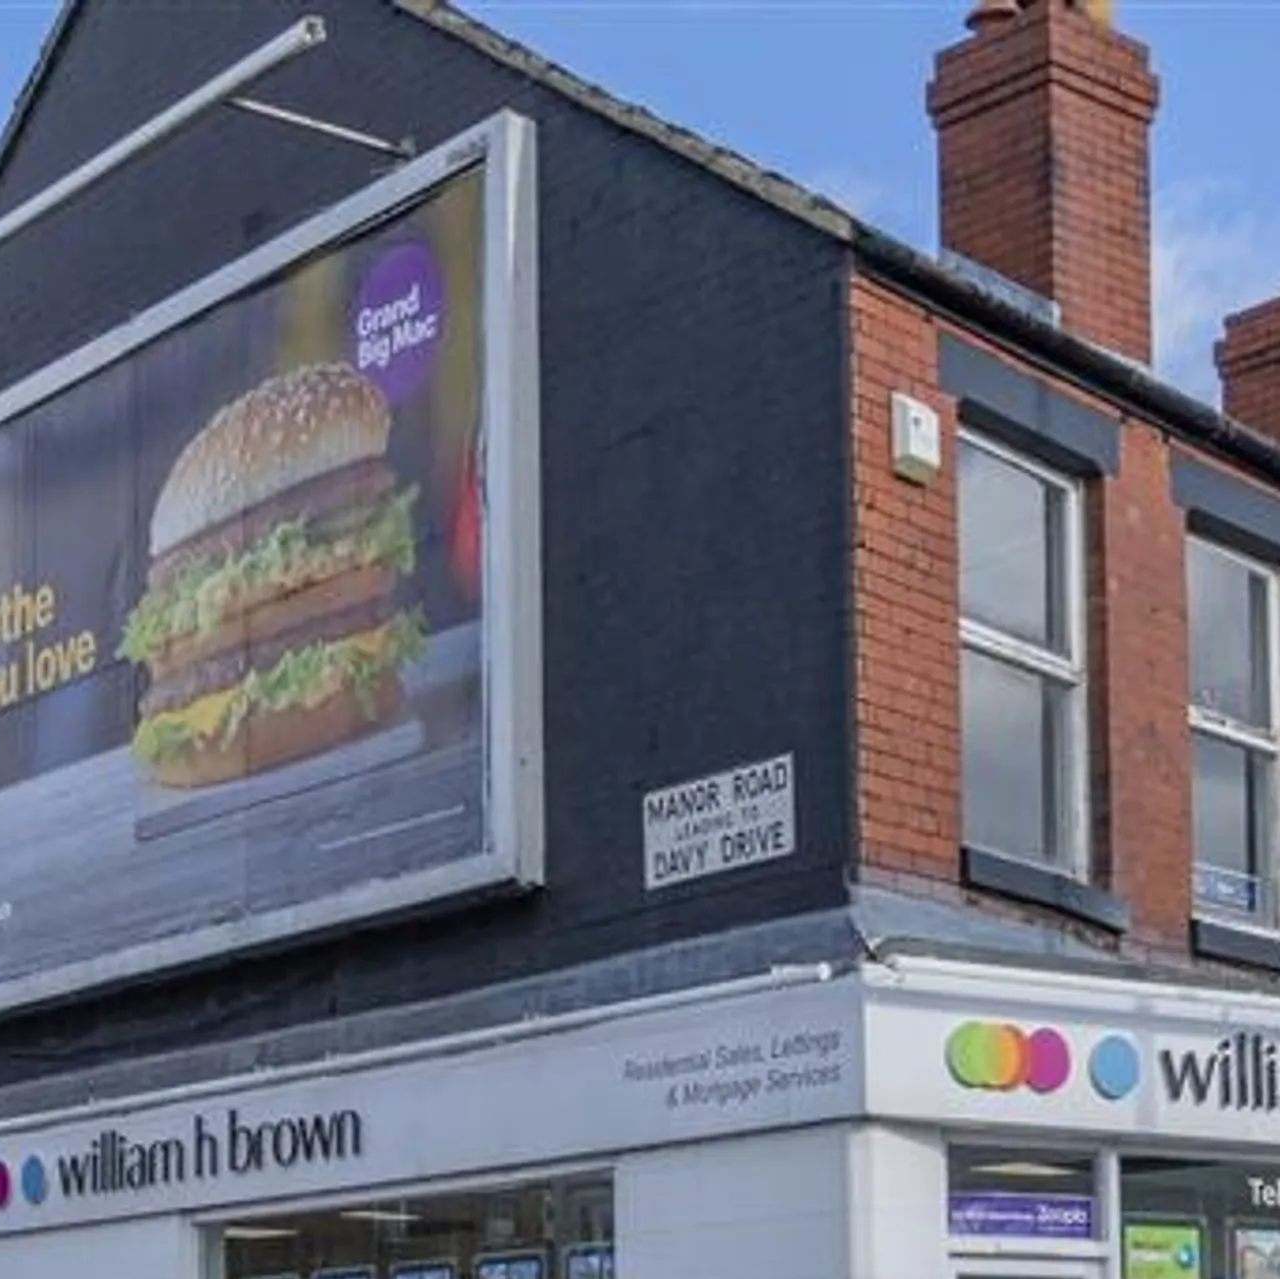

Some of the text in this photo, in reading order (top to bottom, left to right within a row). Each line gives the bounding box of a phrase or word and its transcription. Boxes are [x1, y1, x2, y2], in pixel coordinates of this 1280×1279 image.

[357, 282, 420, 337] Grand
[358, 313, 436, 369] Big Mac
[0, 582, 55, 643] the
[26, 629, 97, 695] love
[648, 762, 787, 826] MANOR ROAD
[654, 821, 785, 880] DAVY DRIVE
[624, 1049, 710, 1081] Residential
[771, 1028, 841, 1059] Lettings
[682, 1076, 762, 1106] Mortgage
[767, 1063, 841, 1092] Services
[58, 1108, 363, 1197] william h brown
